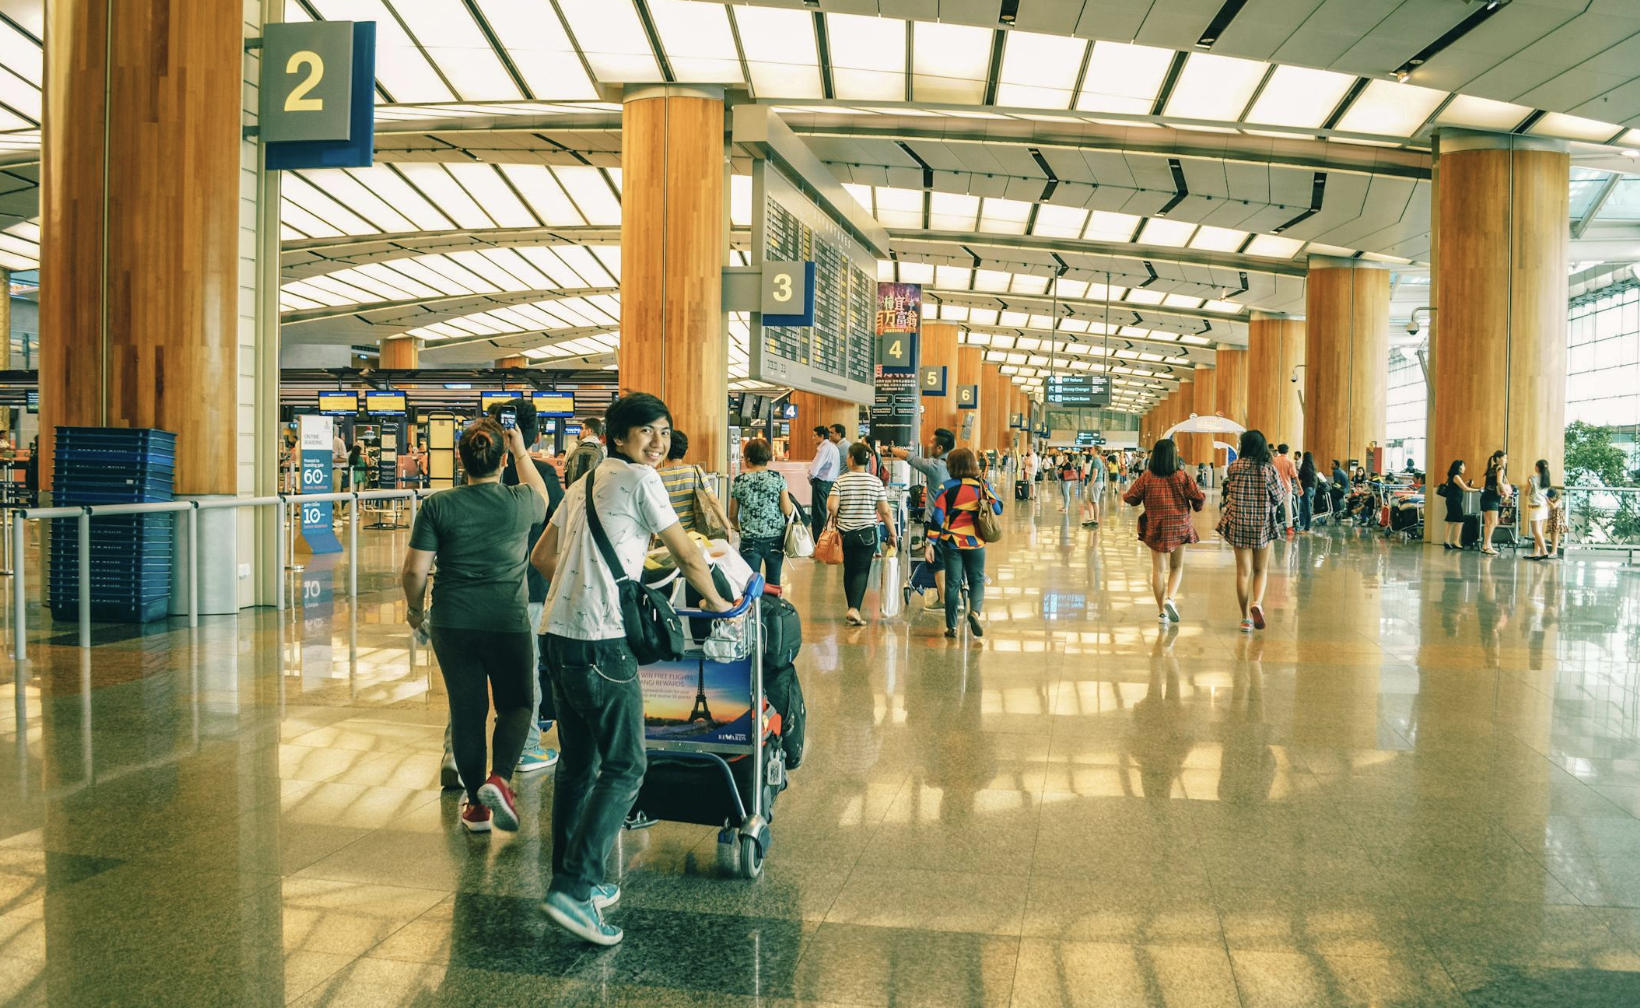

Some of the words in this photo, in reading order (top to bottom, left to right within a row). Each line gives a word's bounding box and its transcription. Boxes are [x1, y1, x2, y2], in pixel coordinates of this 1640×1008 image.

[284, 50, 324, 111] 2
[773, 273, 792, 302] 3
[889, 340, 903, 359] 4
[927, 371, 937, 386] 5
[961, 389, 970, 401] 6
[786, 405, 796, 418] 4
[1012, 415, 1018, 423] 7
[1022, 419, 1028, 427] 8
[304, 469, 323, 484] 60
[304, 508, 320, 524] 10
